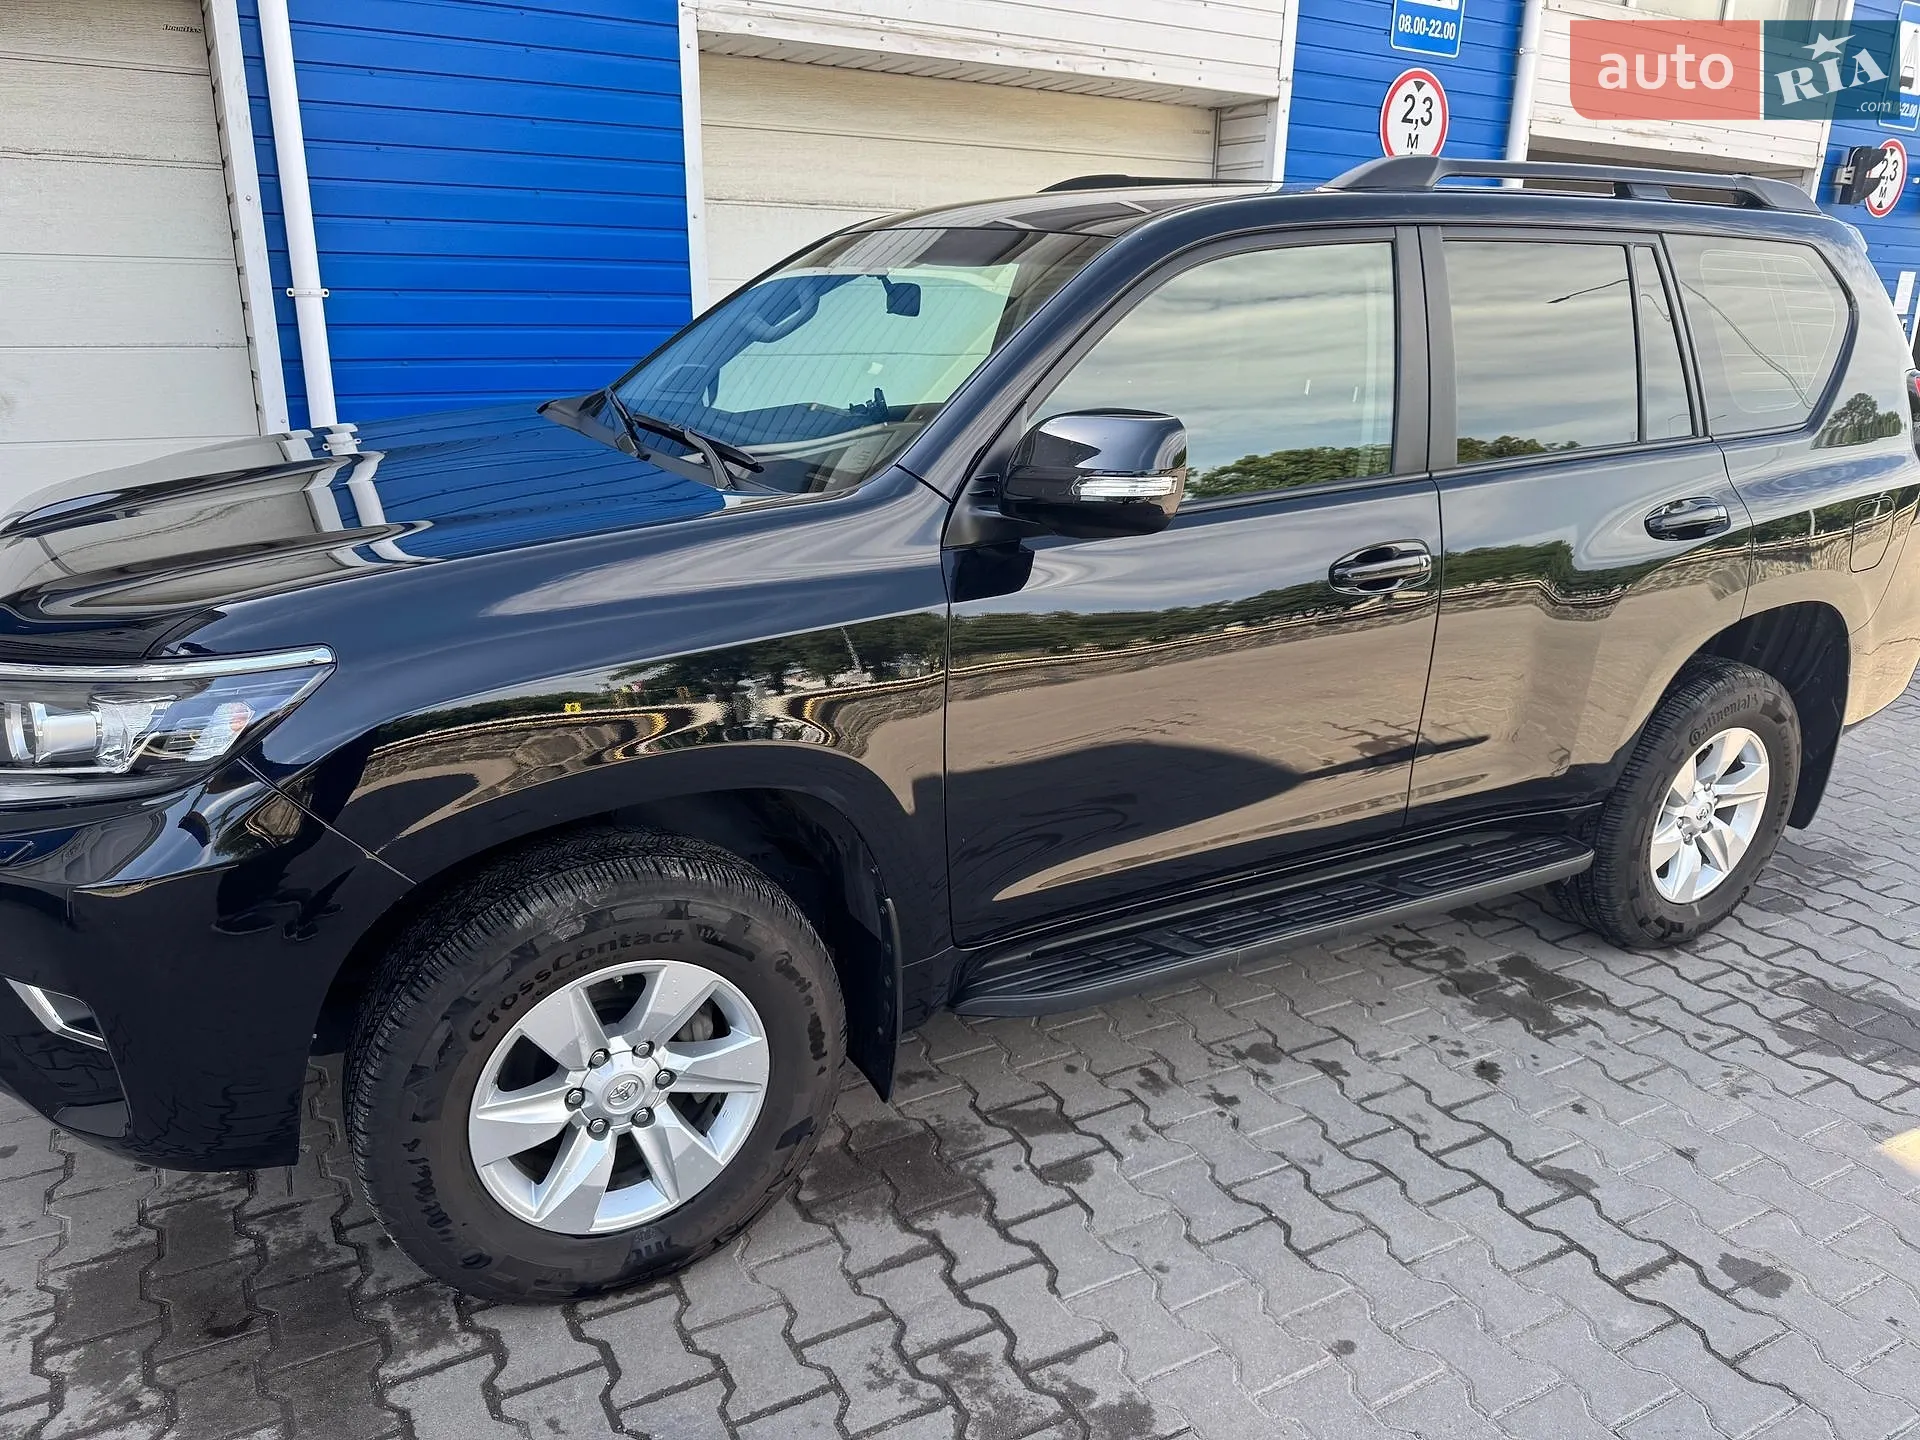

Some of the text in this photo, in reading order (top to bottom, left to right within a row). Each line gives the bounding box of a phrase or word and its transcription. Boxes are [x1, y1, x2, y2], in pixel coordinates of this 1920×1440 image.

[1398, 14, 1456, 40] 08.00-22.00
[1401, 94, 1433, 130] 2,3
[1880, 158, 1898, 184] 2,3
[469, 928, 684, 1042] CrossContact
